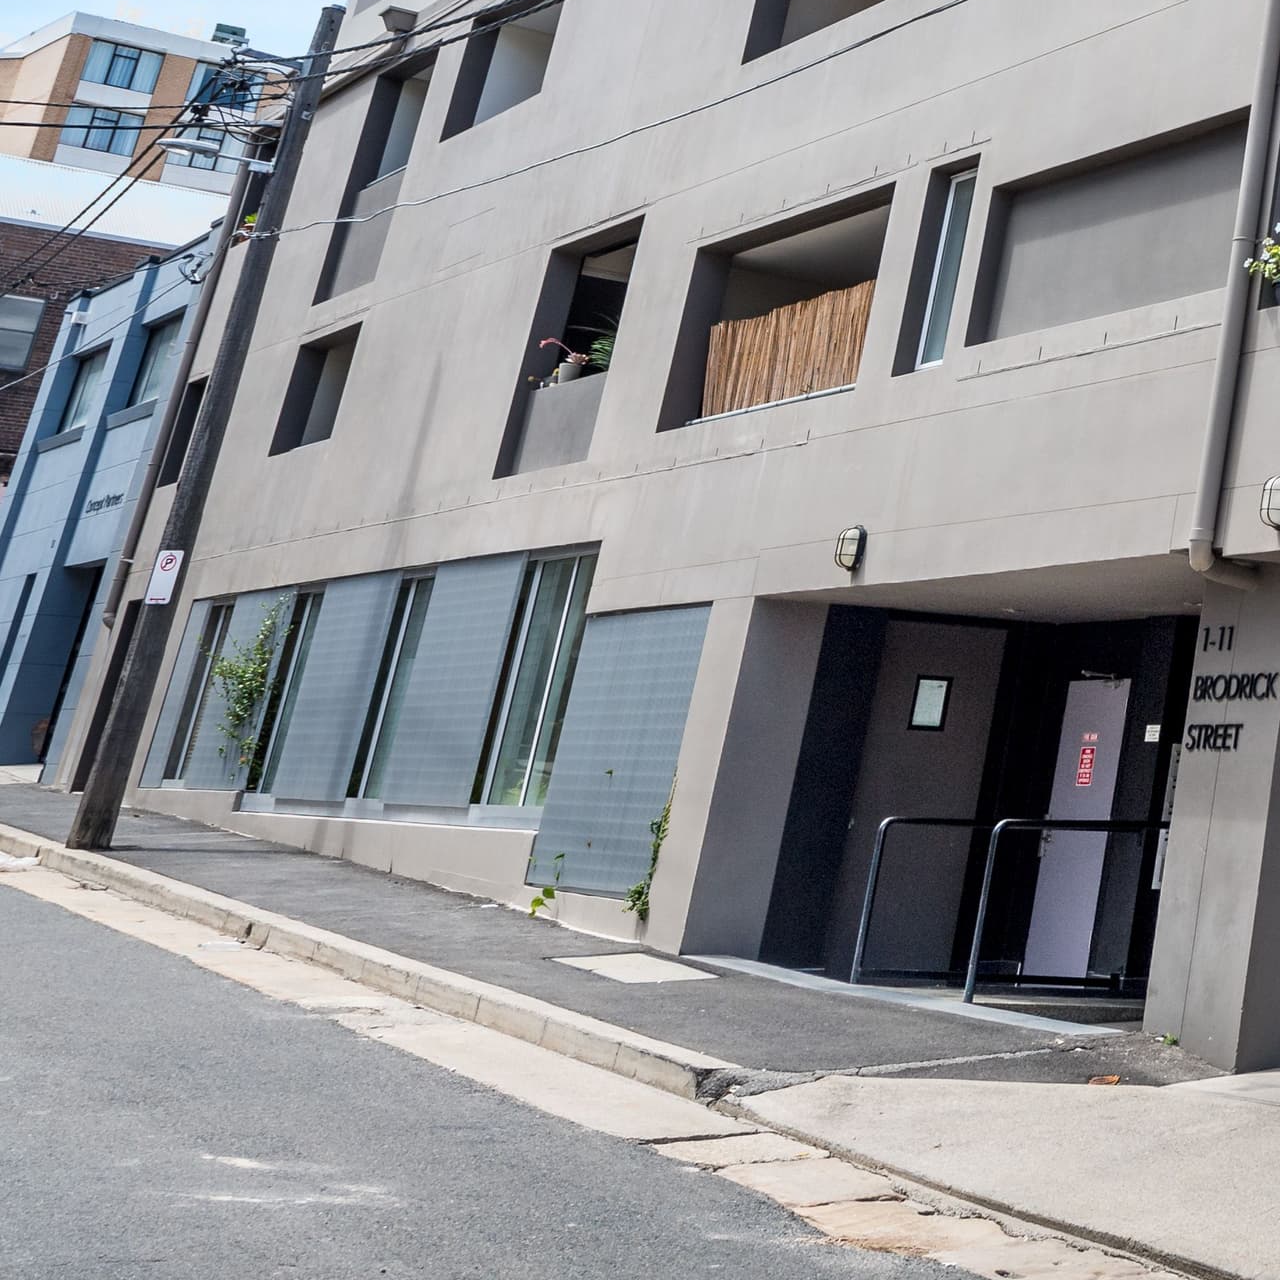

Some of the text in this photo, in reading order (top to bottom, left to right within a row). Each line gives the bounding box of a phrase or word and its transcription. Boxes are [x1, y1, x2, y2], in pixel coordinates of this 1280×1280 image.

[1202, 625, 1234, 652] 1-11
[1193, 672, 1279, 701] BRODRICK
[1185, 723, 1244, 751] STREET
